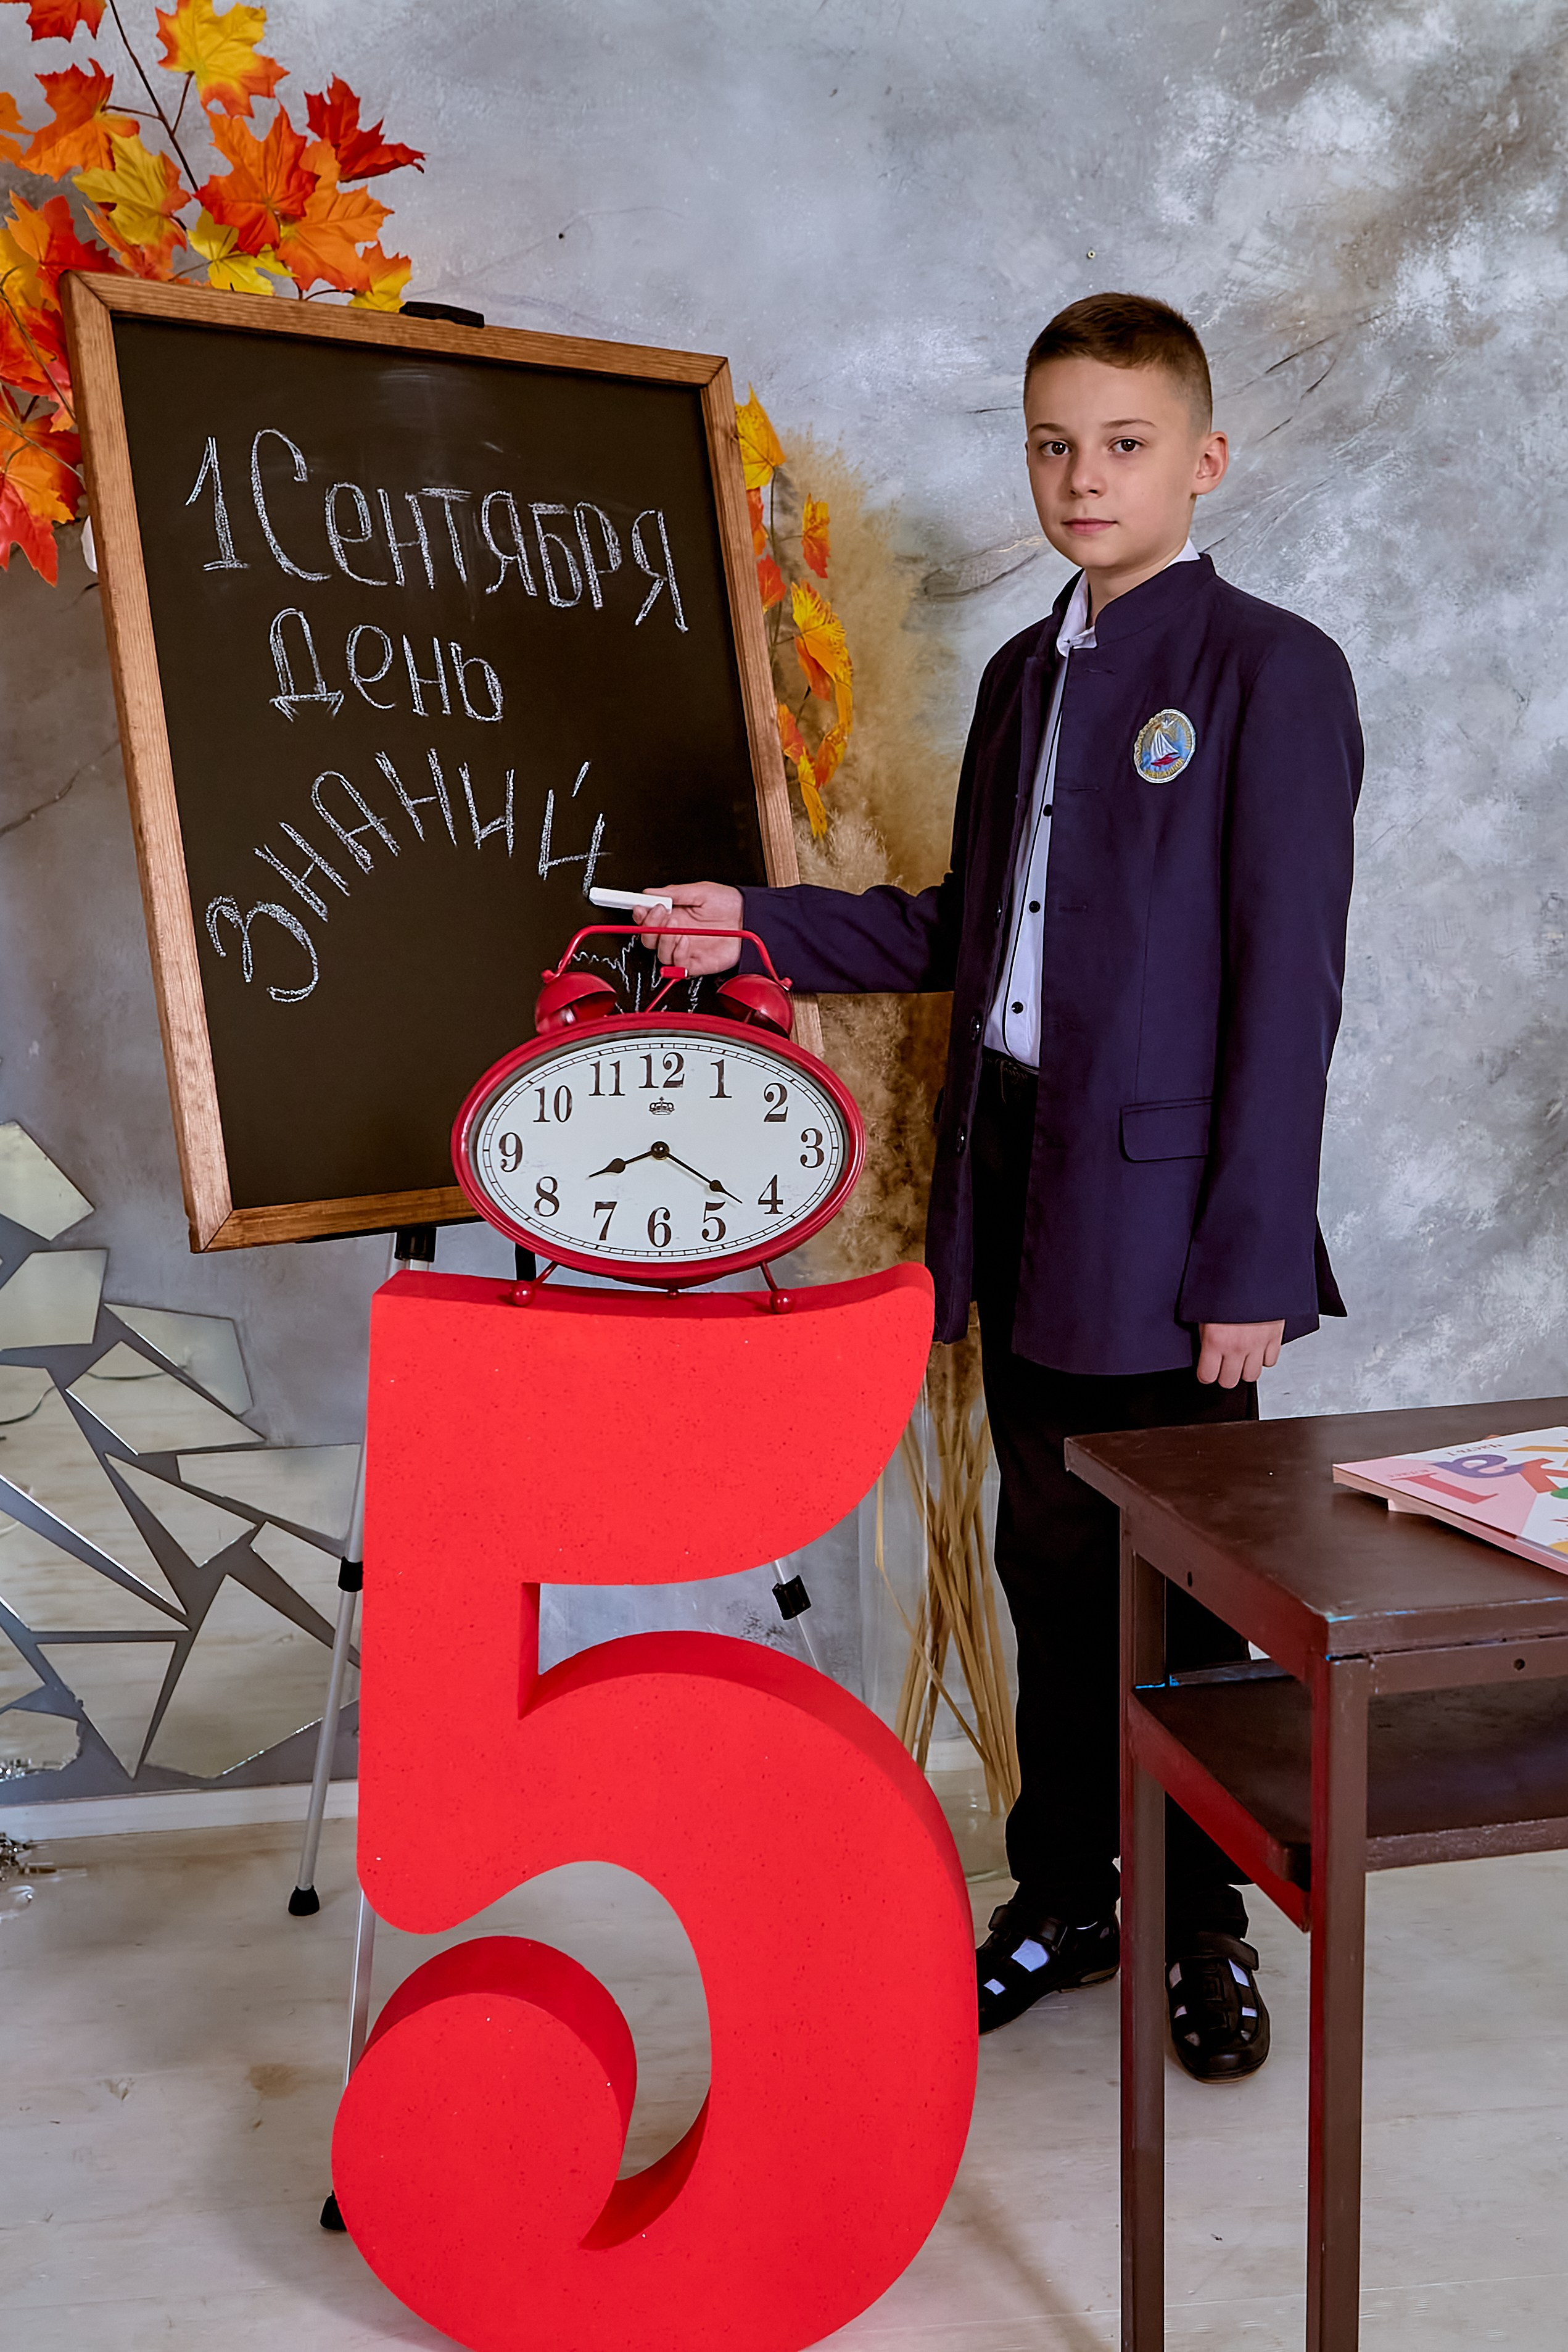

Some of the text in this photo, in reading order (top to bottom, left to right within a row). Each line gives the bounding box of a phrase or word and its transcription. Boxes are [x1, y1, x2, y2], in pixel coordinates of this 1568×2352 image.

[186, 436, 250, 571] 1
[269, 608, 503, 722] День
[588, 1060, 626, 1096] 11
[639, 1051, 685, 1088] 12
[709, 1058, 732, 1099] 1
[532, 1084, 573, 1123] 10
[763, 1082, 789, 1122] 2
[498, 1132, 523, 1172] 9
[800, 1128, 824, 1169] 3
[534, 1176, 559, 1217] 8
[757, 1174, 783, 1215] 4
[593, 1201, 617, 1241] 7
[647, 1206, 672, 1248] 6
[701, 1201, 727, 1243] 5
[1390, 1473, 1499, 1504] 1
[331, 1262, 978, 2352] 5
